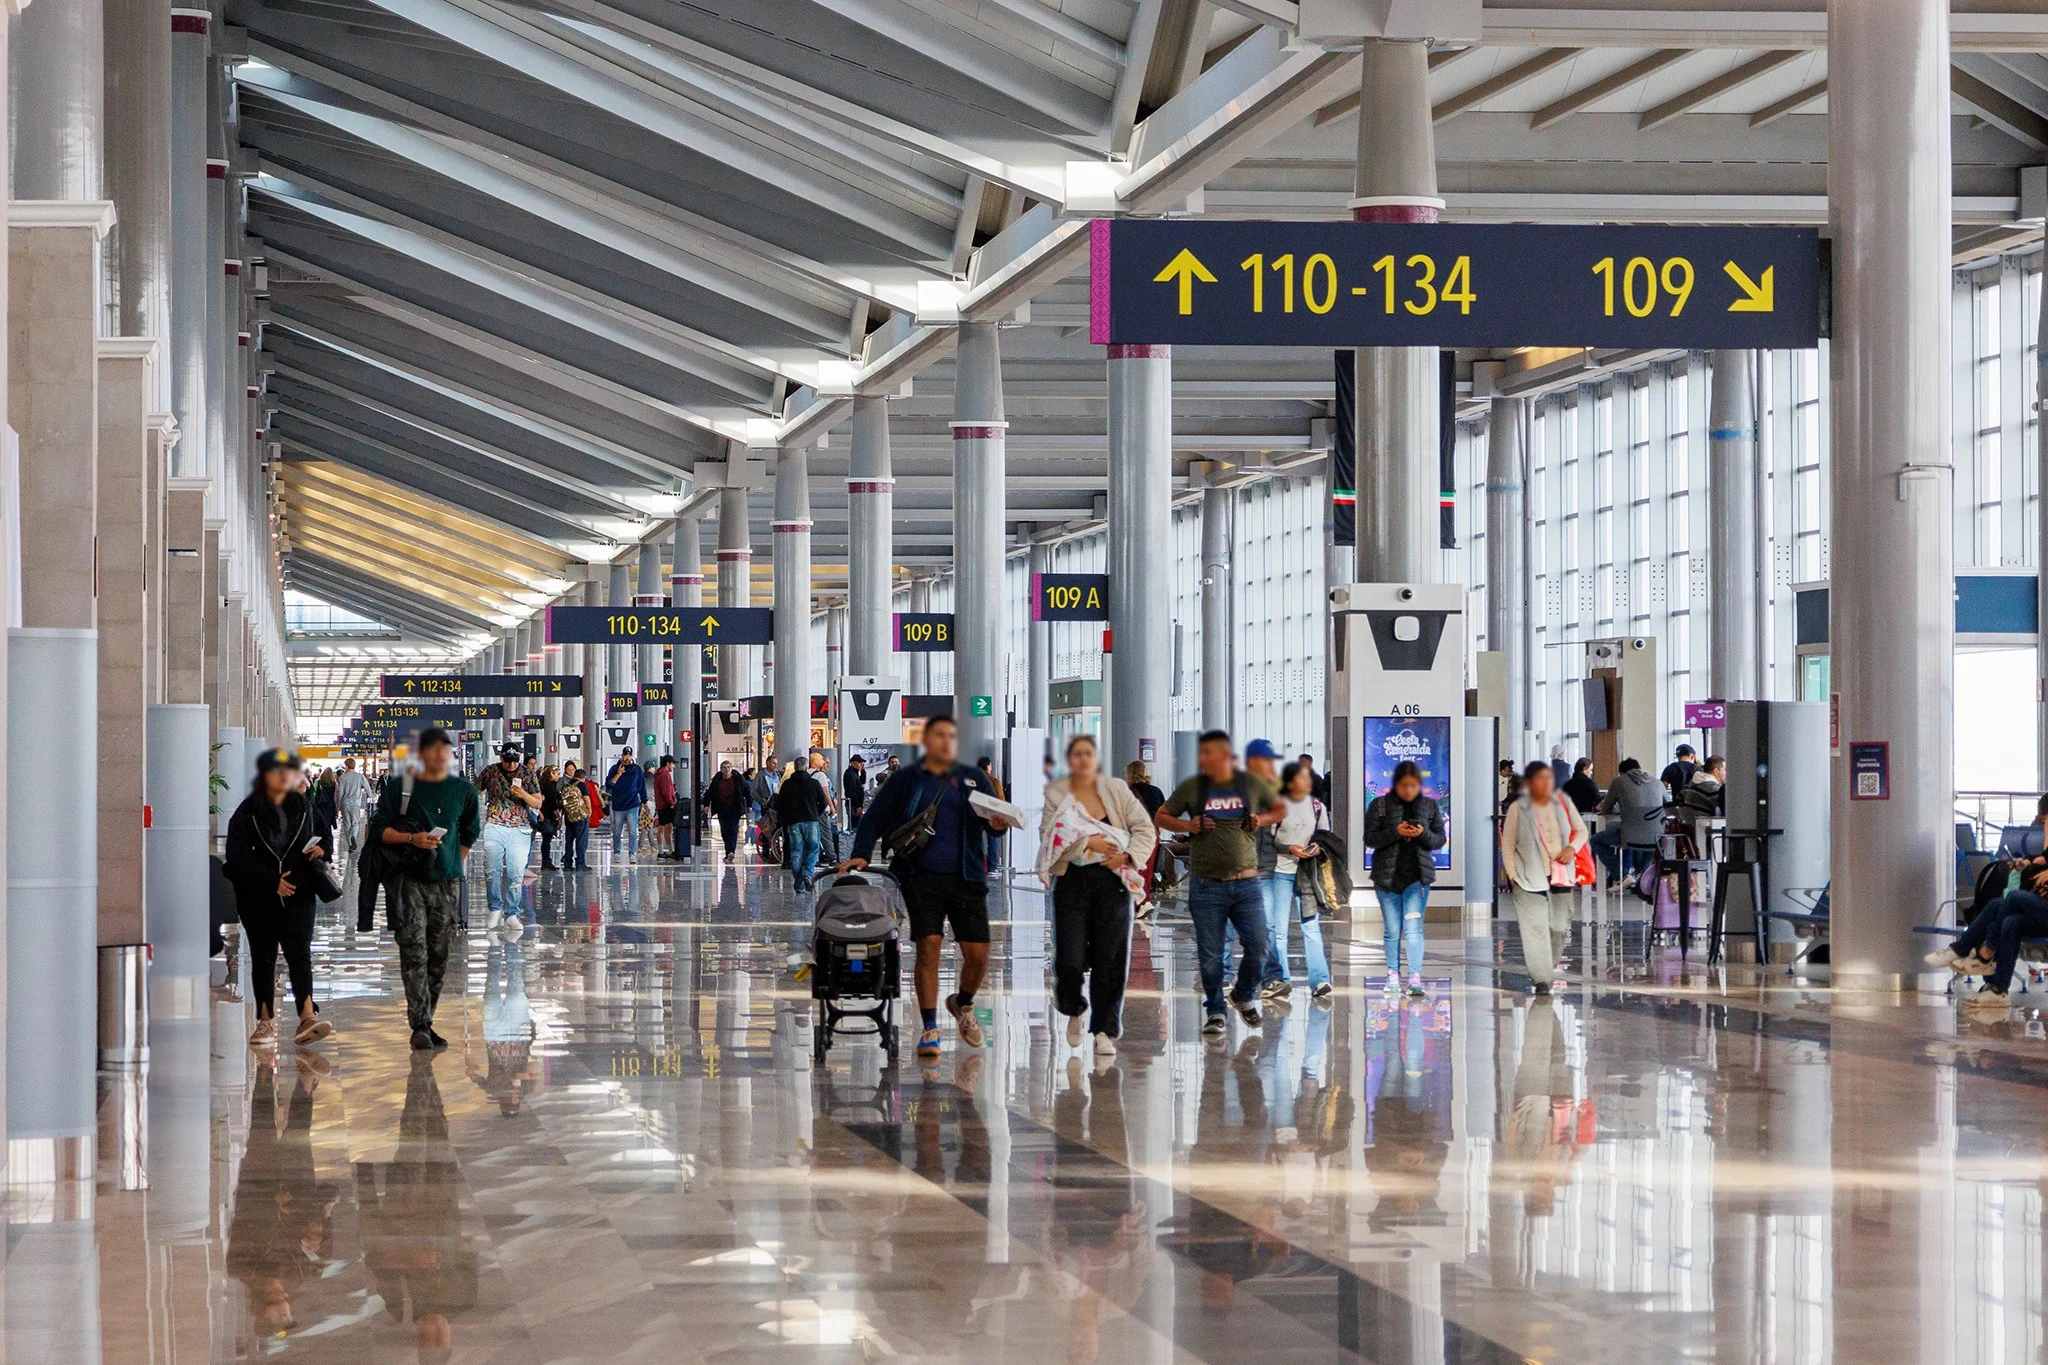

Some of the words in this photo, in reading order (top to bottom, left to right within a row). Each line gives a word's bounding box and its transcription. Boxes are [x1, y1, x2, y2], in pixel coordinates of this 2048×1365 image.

[1239, 252, 1478, 316] 110-134
[1591, 255, 1695, 319] 109
[1046, 586, 1082, 609] 109
[1086, 587, 1100, 609] A
[607, 615, 681, 636] 110-134
[903, 623, 932, 642] 109
[936, 624, 948, 641] B
[421, 680, 462, 692] 112-134
[526, 680, 543, 692] 111
[644, 689, 659, 700] 110
[660, 689, 668, 700] A
[611, 697, 625, 708] 110
[626, 697, 633, 707] B
[389, 707, 419, 716] 113-134
[463, 707, 477, 716] 112
[1391, 704, 1401, 715] A
[1404, 704, 1420, 715] 06
[1714, 705, 1724, 720] 3
[373, 720, 398, 728] 114-134
[526, 718, 535, 726] 111
[535, 718, 541, 726] A
[1383, 742, 1431, 756] Esmeralda
